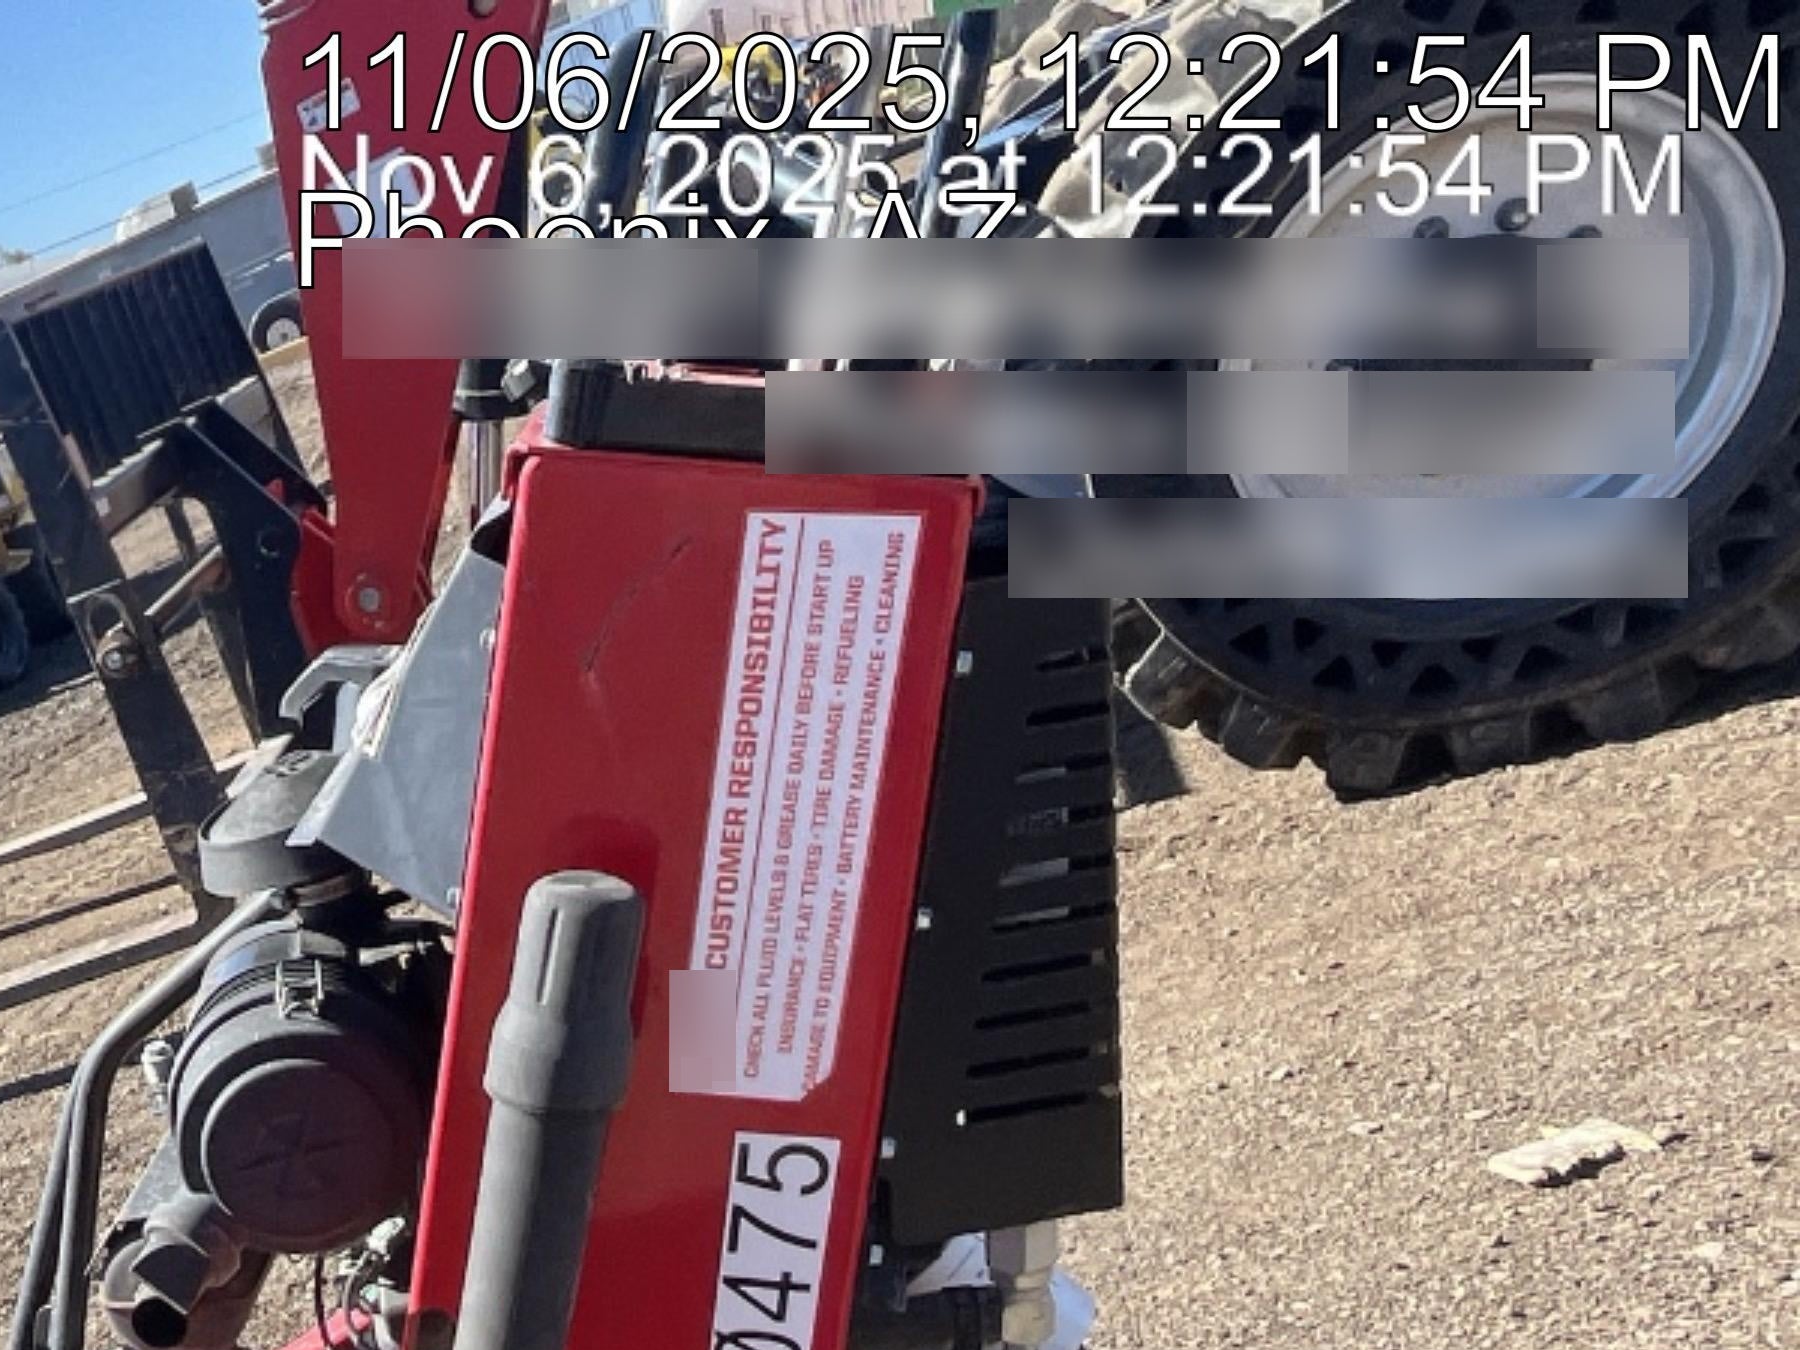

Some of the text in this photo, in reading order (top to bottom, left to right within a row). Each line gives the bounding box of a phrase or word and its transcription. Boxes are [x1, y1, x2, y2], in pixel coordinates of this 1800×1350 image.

[818, 540, 835, 568] UP
[873, 532, 905, 634] CLEANING
[808, 575, 832, 635] START
[795, 641, 821, 714] BEFORE
[705, 519, 786, 969] CUSTOMER RESPONSIBILITY
[788, 720, 809, 774] DAILY
[851, 651, 885, 790] MAINTENANCE
[777, 575, 866, 1054] INSURANCE FLAT TIRES TIRE DAMAGE REFUELING
[777, 780, 801, 850] GREASE
[837, 796, 862, 873] BATTERY
[765, 870, 787, 932] LEVELS
[757, 937, 777, 987] FLUID
[818, 889, 847, 991] EQUIPMENT
[752, 993, 771, 1023] ALL
[814, 998, 831, 1018] TO
[744, 1027, 765, 1078] CHECK
